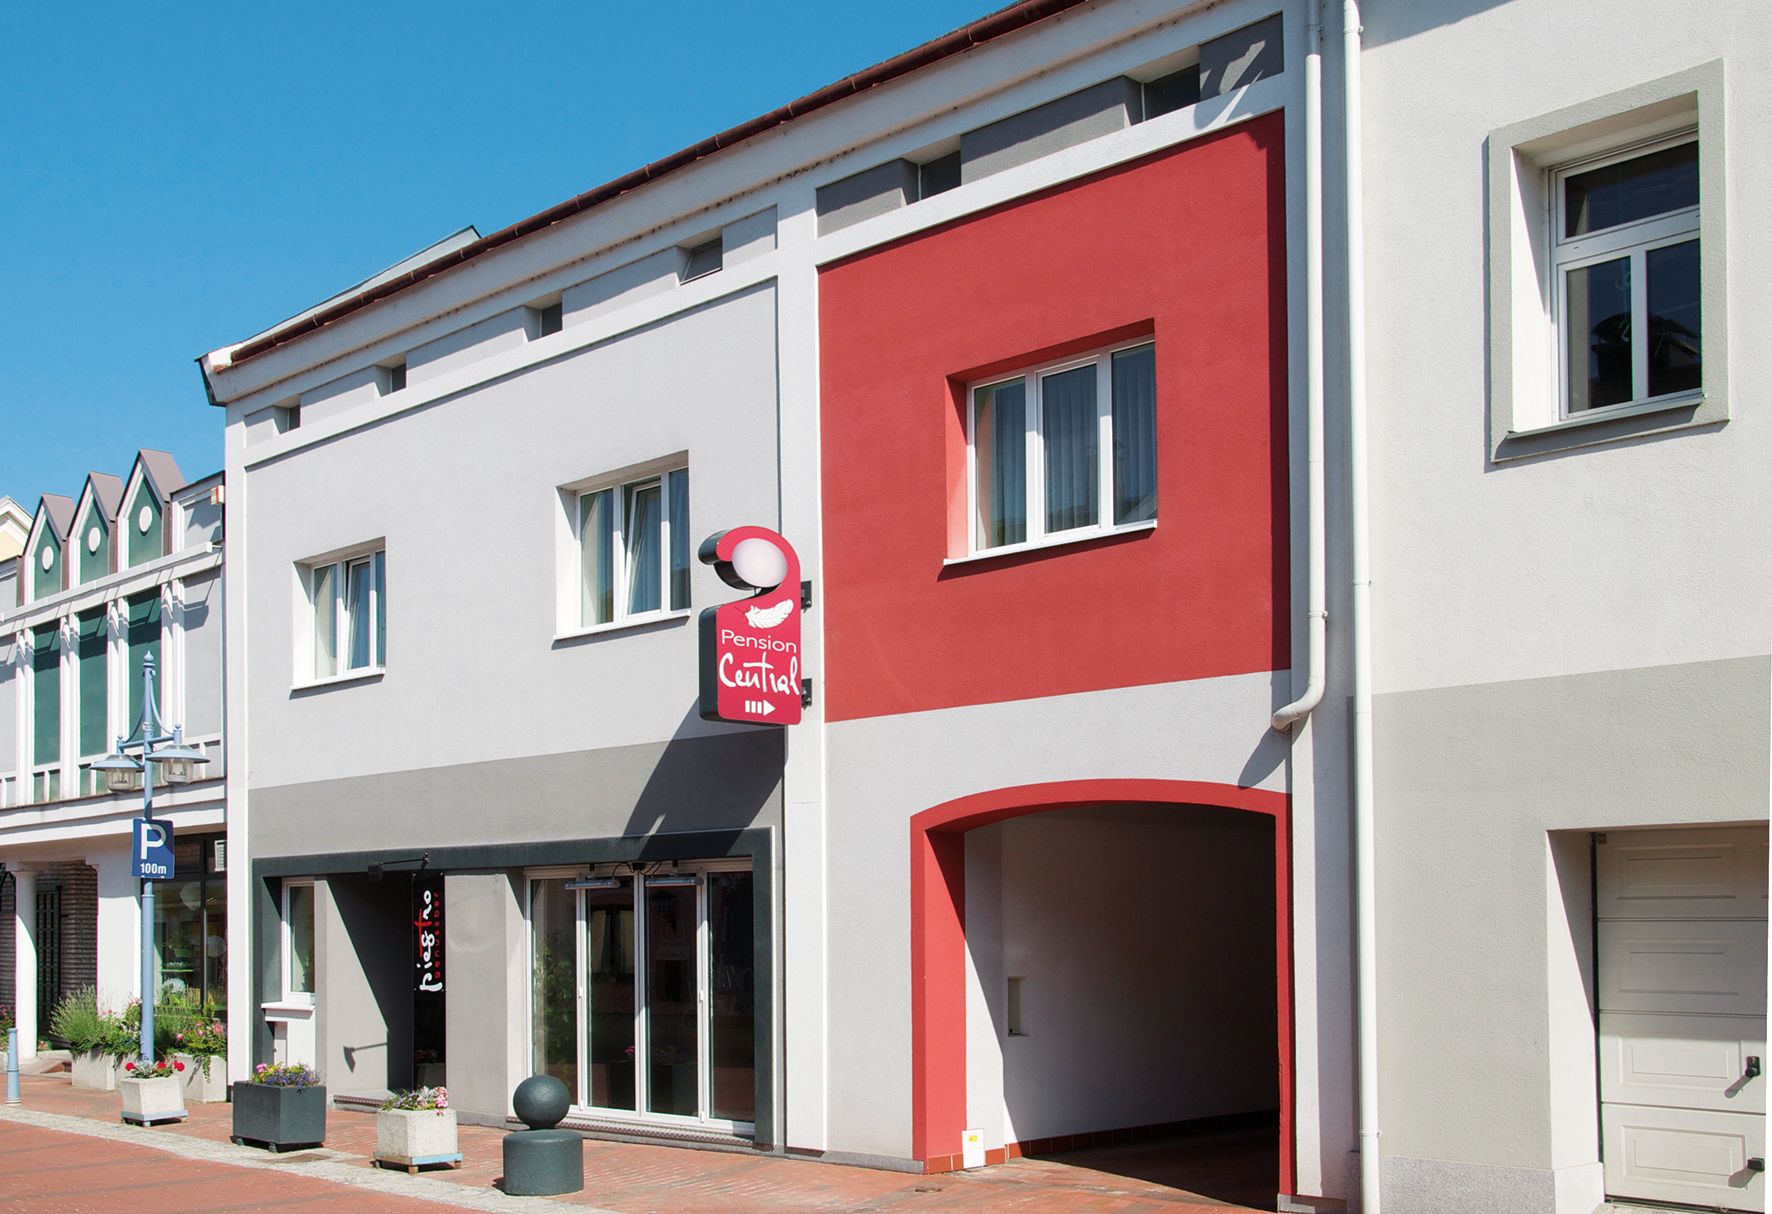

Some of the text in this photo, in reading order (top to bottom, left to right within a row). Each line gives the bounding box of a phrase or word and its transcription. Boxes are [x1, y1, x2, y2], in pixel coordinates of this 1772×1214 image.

[721, 629, 797, 653] Pension
[719, 651, 800, 696] Central
[141, 823, 166, 860] P
[140, 862, 167, 875] 100m
